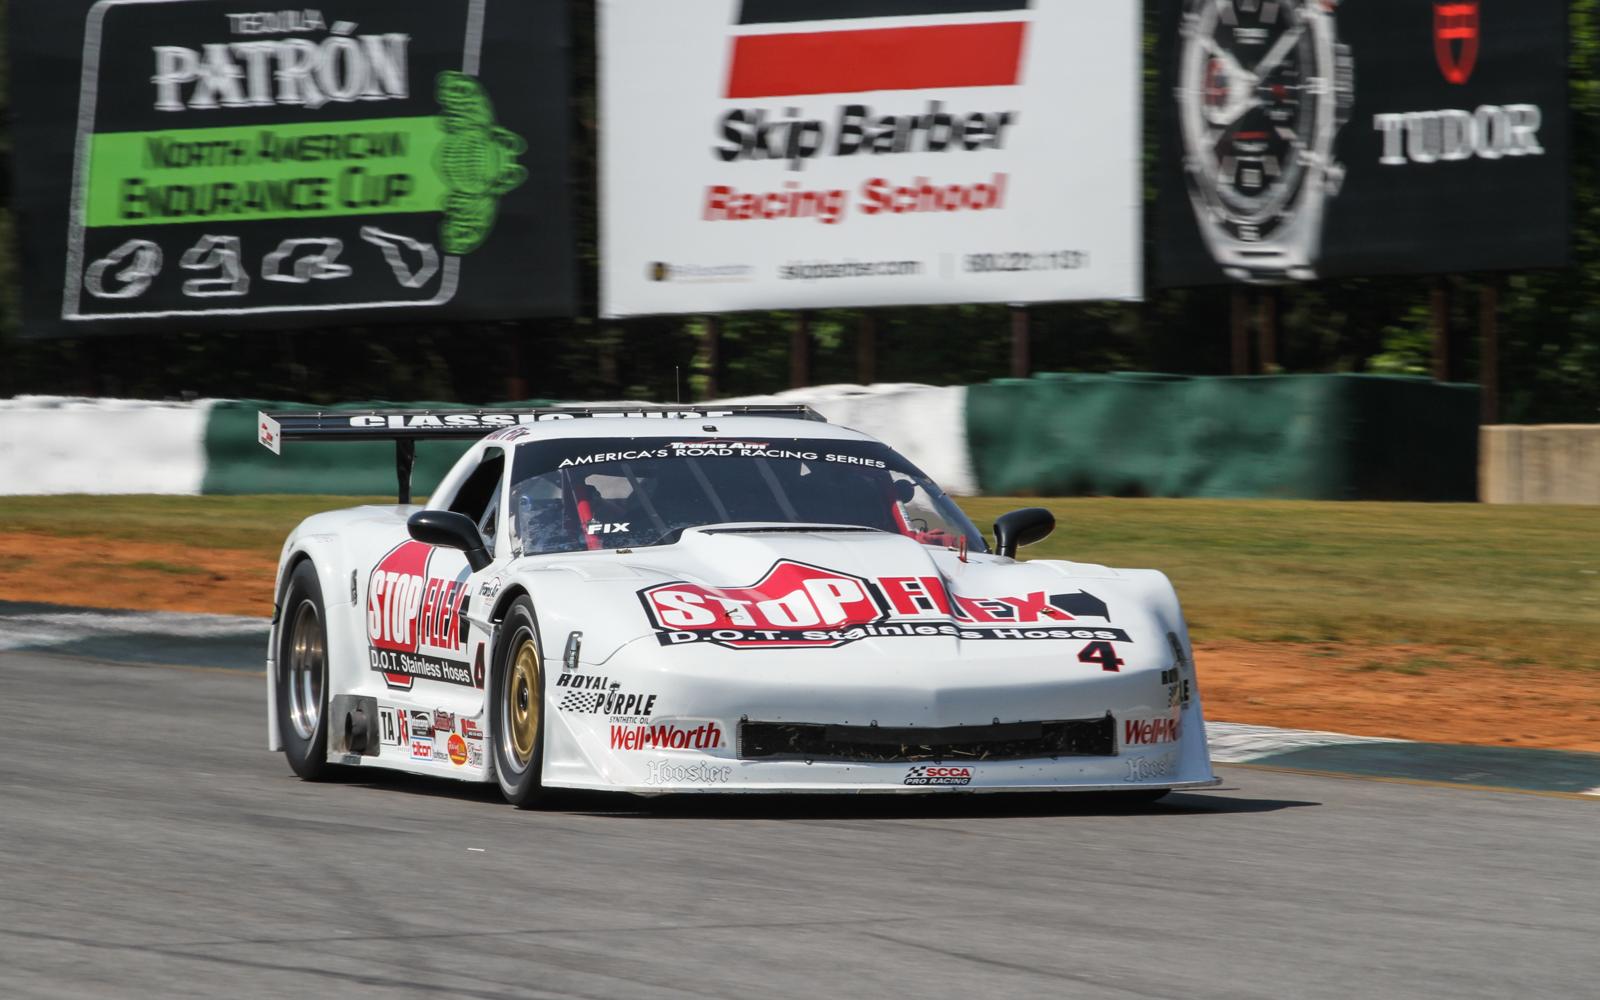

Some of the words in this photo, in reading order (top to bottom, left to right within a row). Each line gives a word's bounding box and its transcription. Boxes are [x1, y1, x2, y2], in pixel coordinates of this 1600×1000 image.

[151, 20, 411, 111] PATRÓN
[709, 107, 828, 172] Skip
[832, 100, 1018, 156] Barber
[1374, 104, 1545, 164] TUDOR
[118, 177, 333, 220] ENDURANCE
[337, 165, 415, 209] CUP
[700, 180, 848, 224] Racing
[858, 172, 1009, 214] School
[558, 449, 668, 468] AMERICA'S
[676, 448, 732, 457] ROAD
[741, 449, 818, 460] RACING
[825, 453, 886, 469] SERIES
[588, 522, 631, 535] FIX
[369, 569, 425, 645] STOP
[421, 577, 469, 651] FLEX
[652, 578, 866, 627] STOP
[877, 576, 1077, 623] FLEX
[670, 629, 790, 644] D.O.T.
[803, 623, 984, 641] Stainless
[992, 628, 1118, 640] Hoses
[370, 649, 400, 671] D.O.T.
[401, 653, 442, 679] Stainless
[441, 660, 471, 684] Hoses
[1076, 640, 1126, 673] 4
[556, 673, 609, 691] ROYAL
[593, 692, 657, 716] PURPLE
[380, 710, 396, 741] TA
[609, 716, 638, 725] SYNTHETIC
[639, 716, 650, 725] OIL
[645, 759, 733, 784] Hoosier
[926, 767, 971, 777] SCCA
